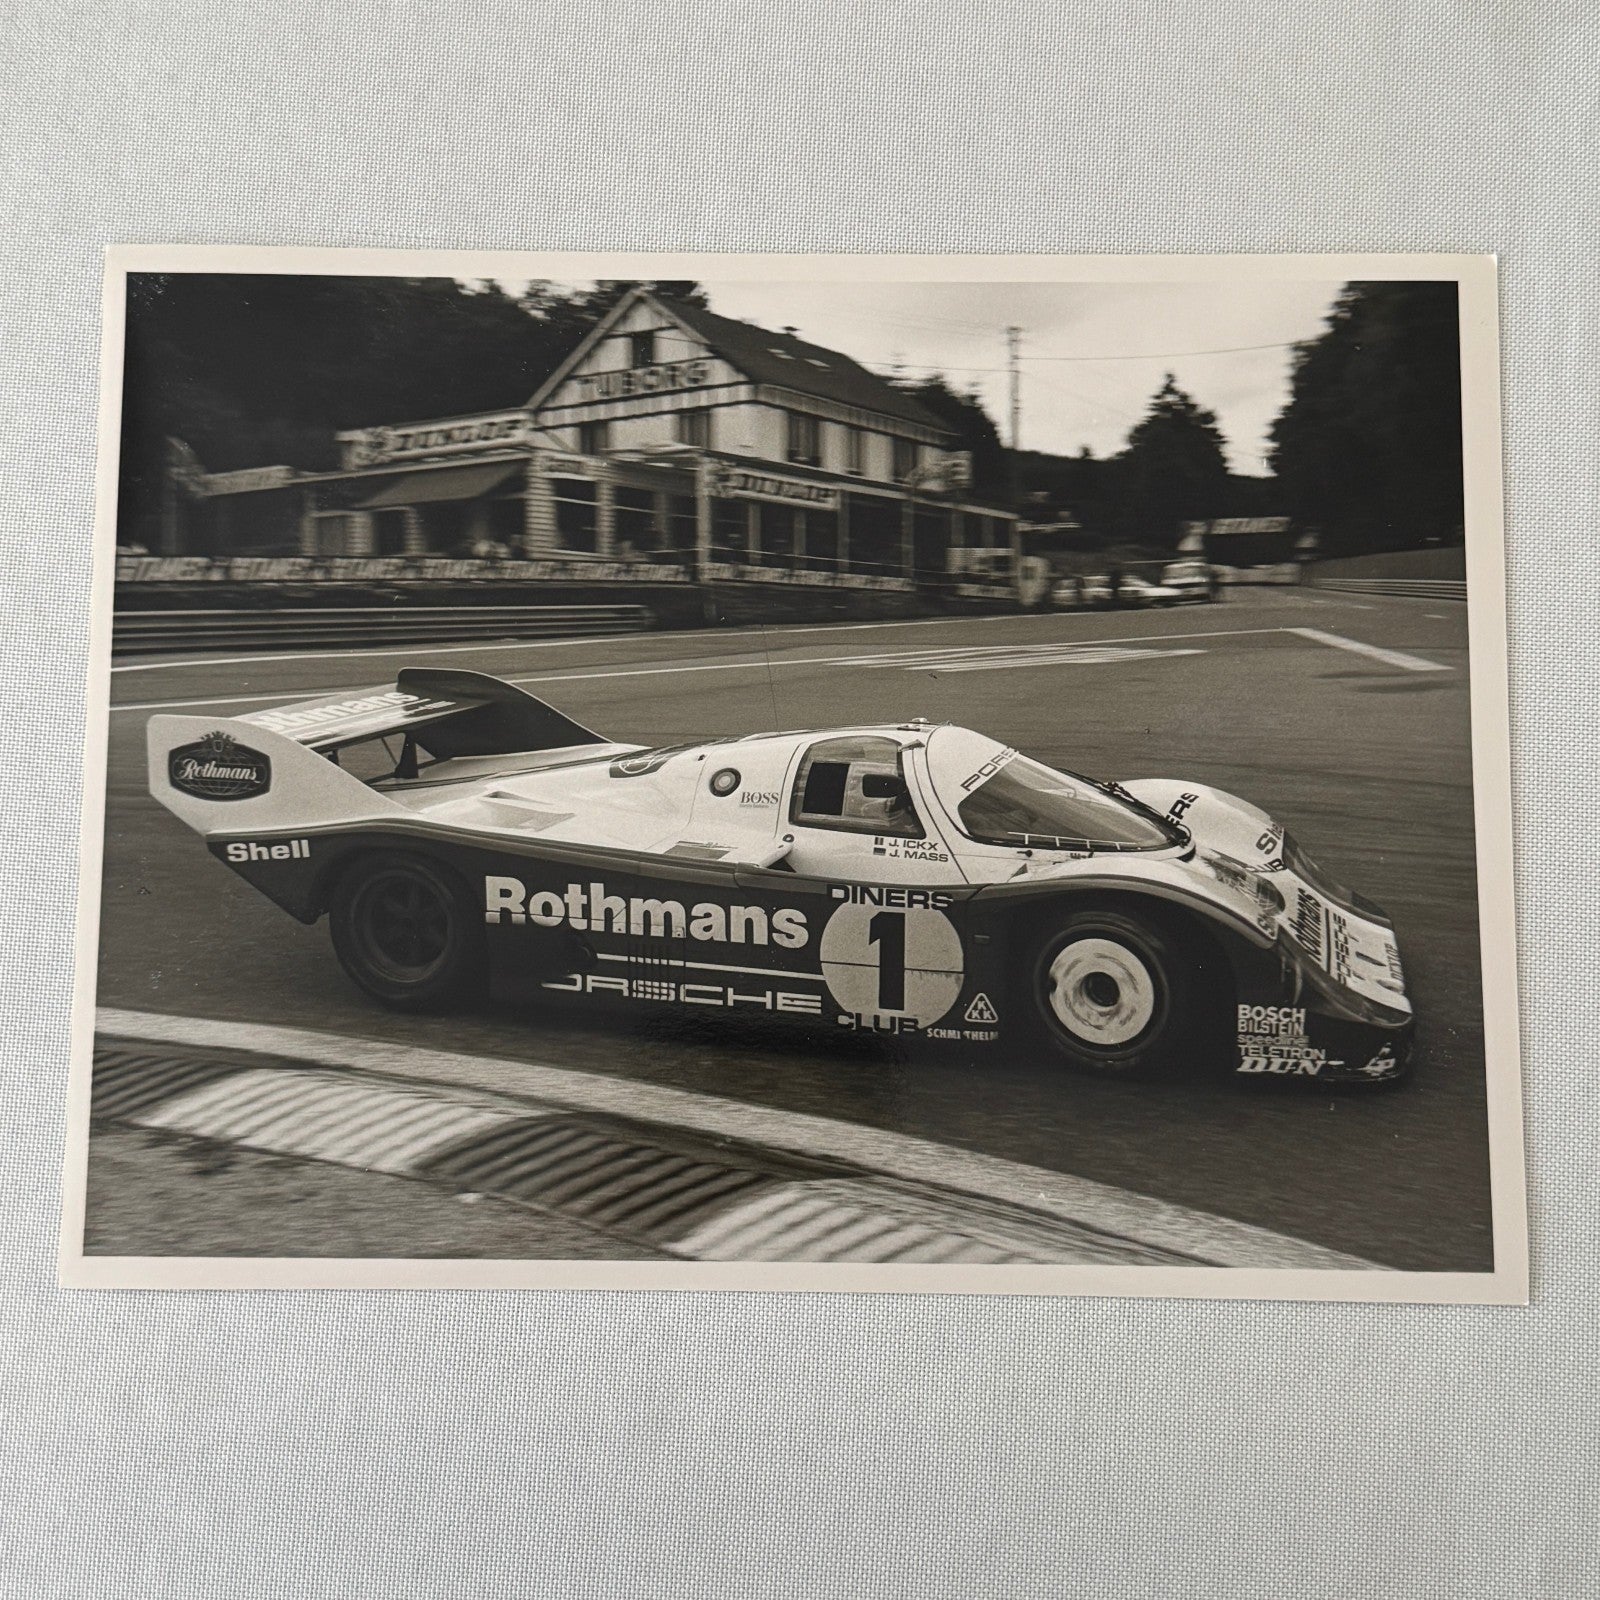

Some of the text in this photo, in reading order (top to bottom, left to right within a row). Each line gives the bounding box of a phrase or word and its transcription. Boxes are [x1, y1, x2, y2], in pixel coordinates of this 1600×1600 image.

[178, 758, 262, 784] Rothmans
[740, 791, 779, 805] BOSS
[226, 839, 310, 863] Shell
[888, 839, 939, 851] J. ICKX
[889, 850, 949, 863] J. MASS
[827, 883, 954, 909] DINERS
[485, 875, 809, 949] Rothmans
[869, 911, 905, 1011] 1
[834, 1011, 922, 1035] CLUB
[1237, 1003, 1306, 1023] BOSCH
[1237, 1019, 1306, 1036] BILSTEIN
[1237, 1044, 1326, 1060] TELETRON
